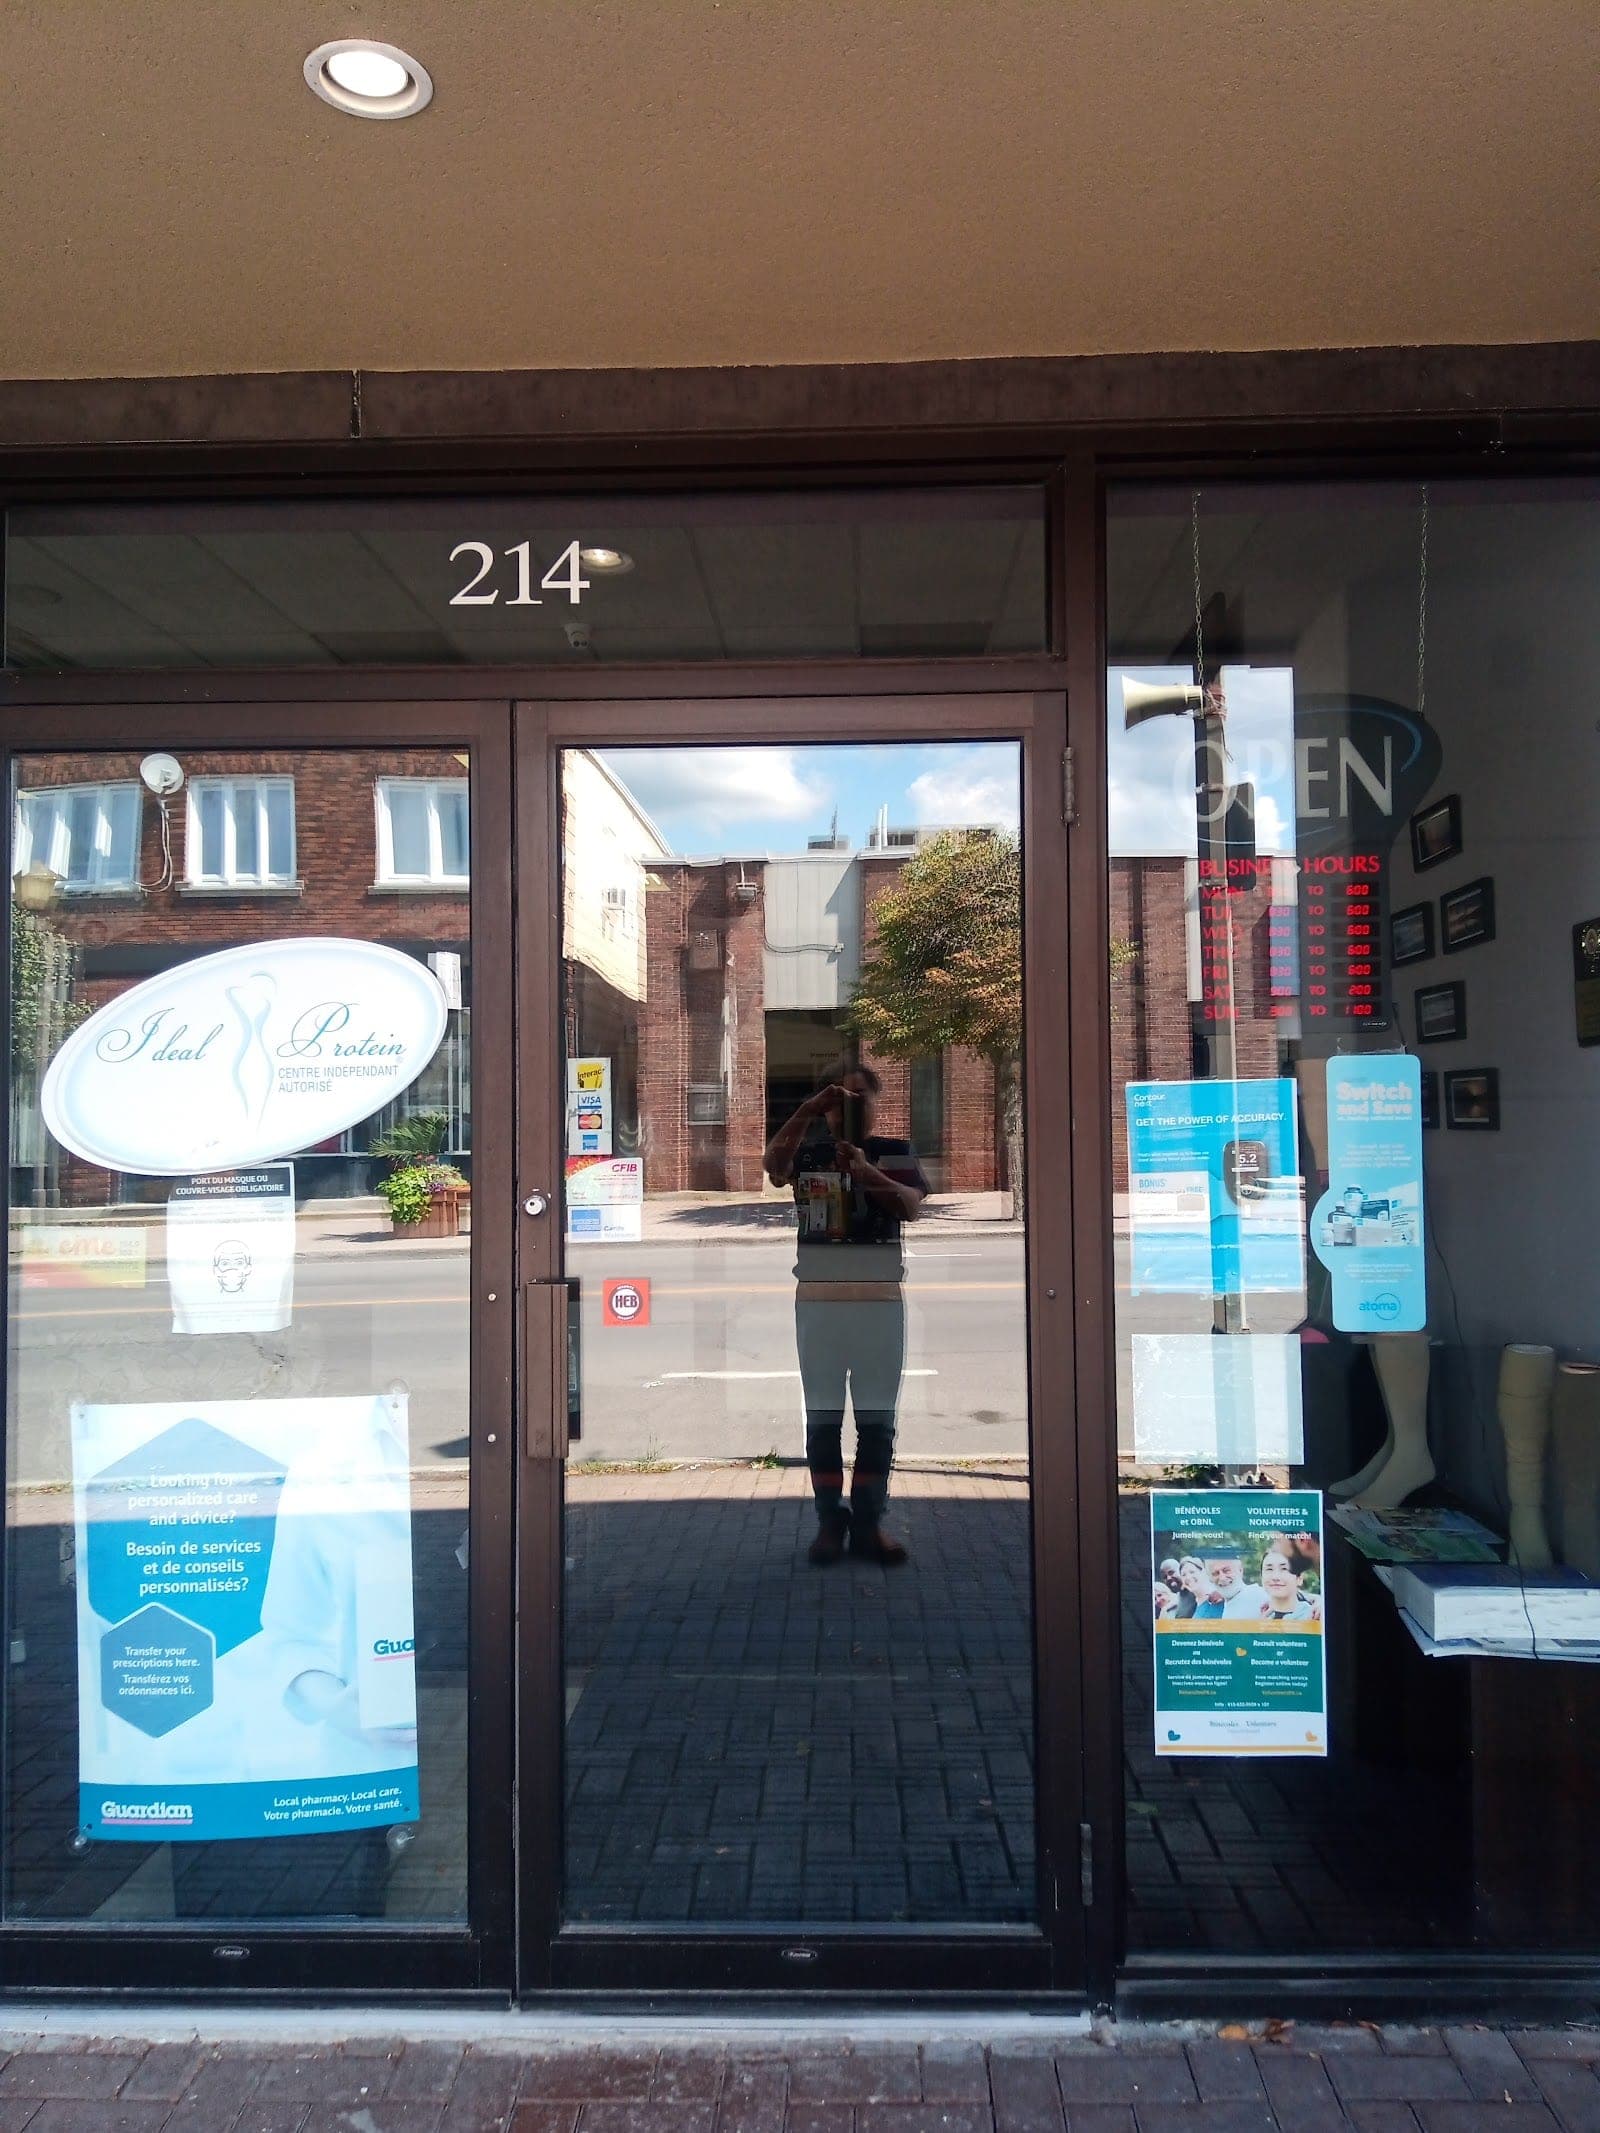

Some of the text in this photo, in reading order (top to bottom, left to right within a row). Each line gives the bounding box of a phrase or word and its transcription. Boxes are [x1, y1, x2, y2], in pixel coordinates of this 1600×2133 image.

[450, 541, 590, 605] 214
[1174, 736, 1393, 823] OPEN
[1304, 856, 1381, 874] HOURS
[1307, 886, 1324, 895] TO
[1308, 906, 1324, 916] TO
[1308, 926, 1325, 936] TO
[1308, 945, 1325, 955] TO
[1309, 965, 1326, 976] TO
[1309, 985, 1326, 995] TO
[1310, 1005, 1327, 1015] TO
[96, 1002, 407, 1063] Ideal Protein
[278, 1066, 321, 1079] CENTRE
[577, 1070, 602, 1080] Interac
[278, 1079, 334, 1093] AUTORISÉ
[1336, 1081, 1412, 1100] Switch
[581, 1096, 601, 1104] VISA
[1337, 1101, 1412, 1115] and Save
[1136, 1112, 1287, 1127] GET THE POWER OF ACCURACY.
[611, 1163, 638, 1172] CFIB
[191, 1177, 211, 1185] PORT
[223, 1175, 256, 1184] MASQUE
[176, 1184, 285, 1195] COUVRE-VISAGE OBLIGATOIRE
[615, 1295, 638, 1308] HEB
[1358, 1301, 1398, 1311] atoma
[150, 1472, 233, 1489] Looking for
[128, 1492, 258, 1510] personalized care
[1174, 1506, 1221, 1515] BÉNÉVOLES
[1246, 1507, 1300, 1515] VOLUNTEERS
[150, 1510, 237, 1526] and advice?
[1190, 1518, 1214, 1526] OBNL
[1249, 1518, 1305, 1526] NON-PROFITS
[1248, 1531, 1265, 1539] Find
[126, 1540, 261, 1556] Besoin de services
[143, 1559, 244, 1575] et de conseils
[139, 1577, 249, 1597] personnalisés?
[124, 1646, 187, 1657] Transfer your
[113, 1658, 200, 1669] prescriptions here.
[122, 1674, 171, 1684] Transférez
[118, 1685, 195, 1696] ordonnances ici.
[274, 1788, 402, 1808] Local pharmacy. Local care.
[101, 1800, 193, 1820] Guardian
[264, 1799, 402, 1821] Votre pharmacie. Votre santé.
